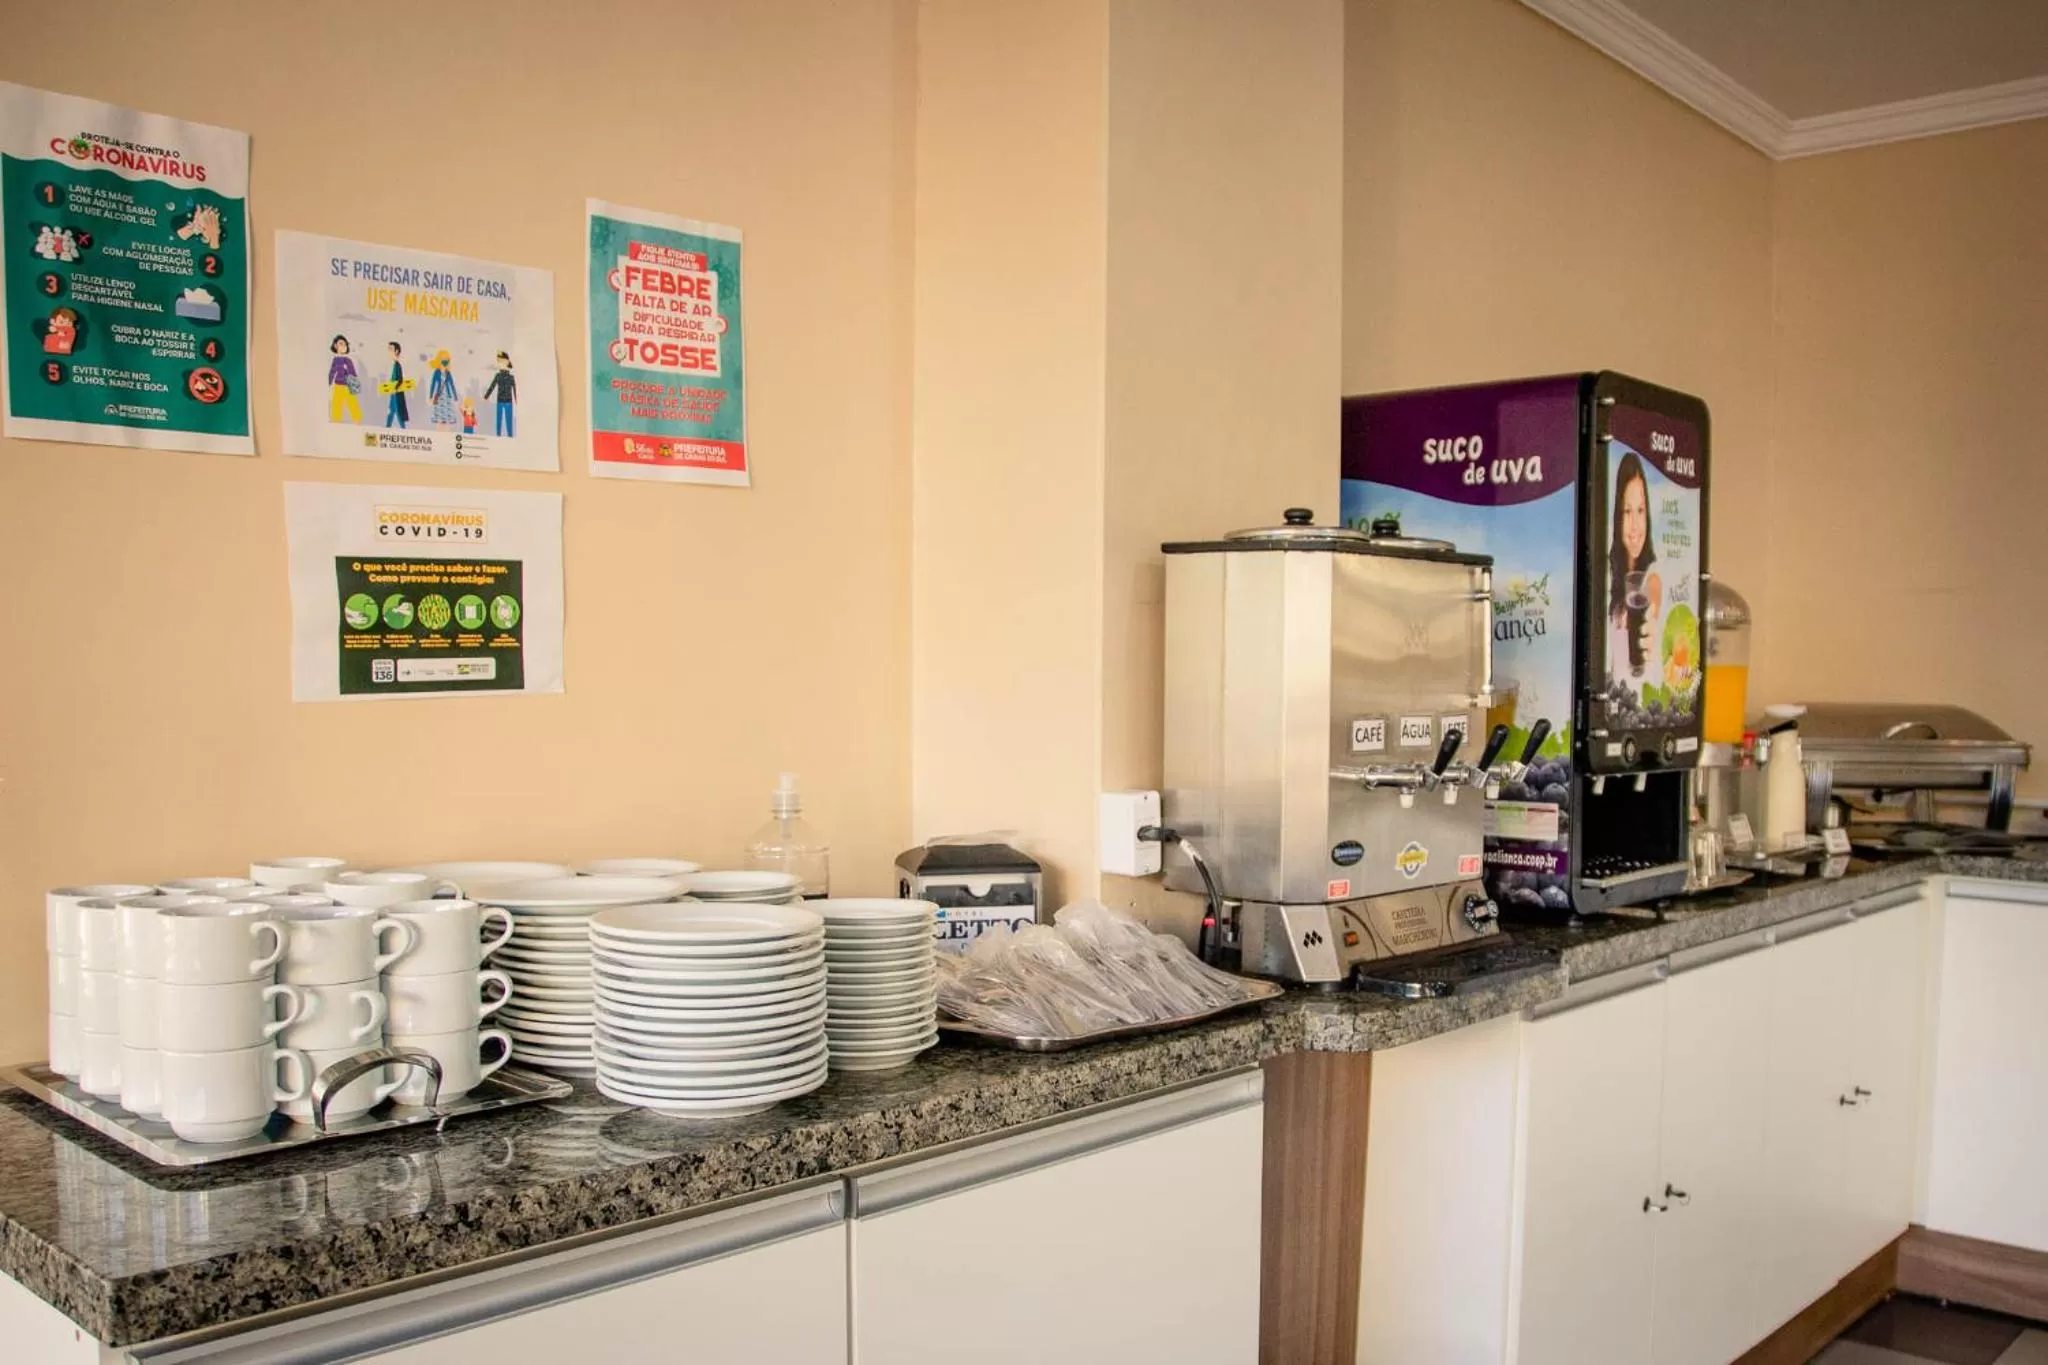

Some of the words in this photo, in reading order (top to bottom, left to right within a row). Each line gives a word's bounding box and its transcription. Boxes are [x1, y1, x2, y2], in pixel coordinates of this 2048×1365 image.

[44, 184, 54, 203] 1
[204, 256, 216, 274] 2
[45, 275, 58, 293] 3
[331, 257, 348, 277] SE
[353, 261, 420, 288] PRECISAR
[423, 270, 453, 292] SAIR
[457, 276, 473, 295] DE
[477, 279, 512, 302] CASA,
[625, 266, 711, 302] FEBRE
[367, 287, 399, 313] USE
[625, 293, 666, 310] FALTA
[670, 300, 688, 314] DE
[692, 304, 712, 317] AR
[623, 321, 654, 335] PARA
[633, 311, 705, 330] DIFICULDADE
[205, 341, 216, 358] 4
[624, 338, 718, 371] TOSSE
[48, 363, 60, 381] 5
[379, 433, 433, 445] PREFEITURA
[1651, 430, 1676, 453] suco
[1423, 435, 1484, 465] suco
[1463, 462, 1486, 485] de
[1490, 456, 1543, 483] uva
[1676, 457, 1696, 478] uva
[352, 562, 361, 571] O
[363, 563, 383, 574] que
[384, 562, 408, 572] você
[368, 573, 399, 584] Como
[1494, 618, 1546, 646] ança
[1355, 725, 1383, 743] CAFÉ
